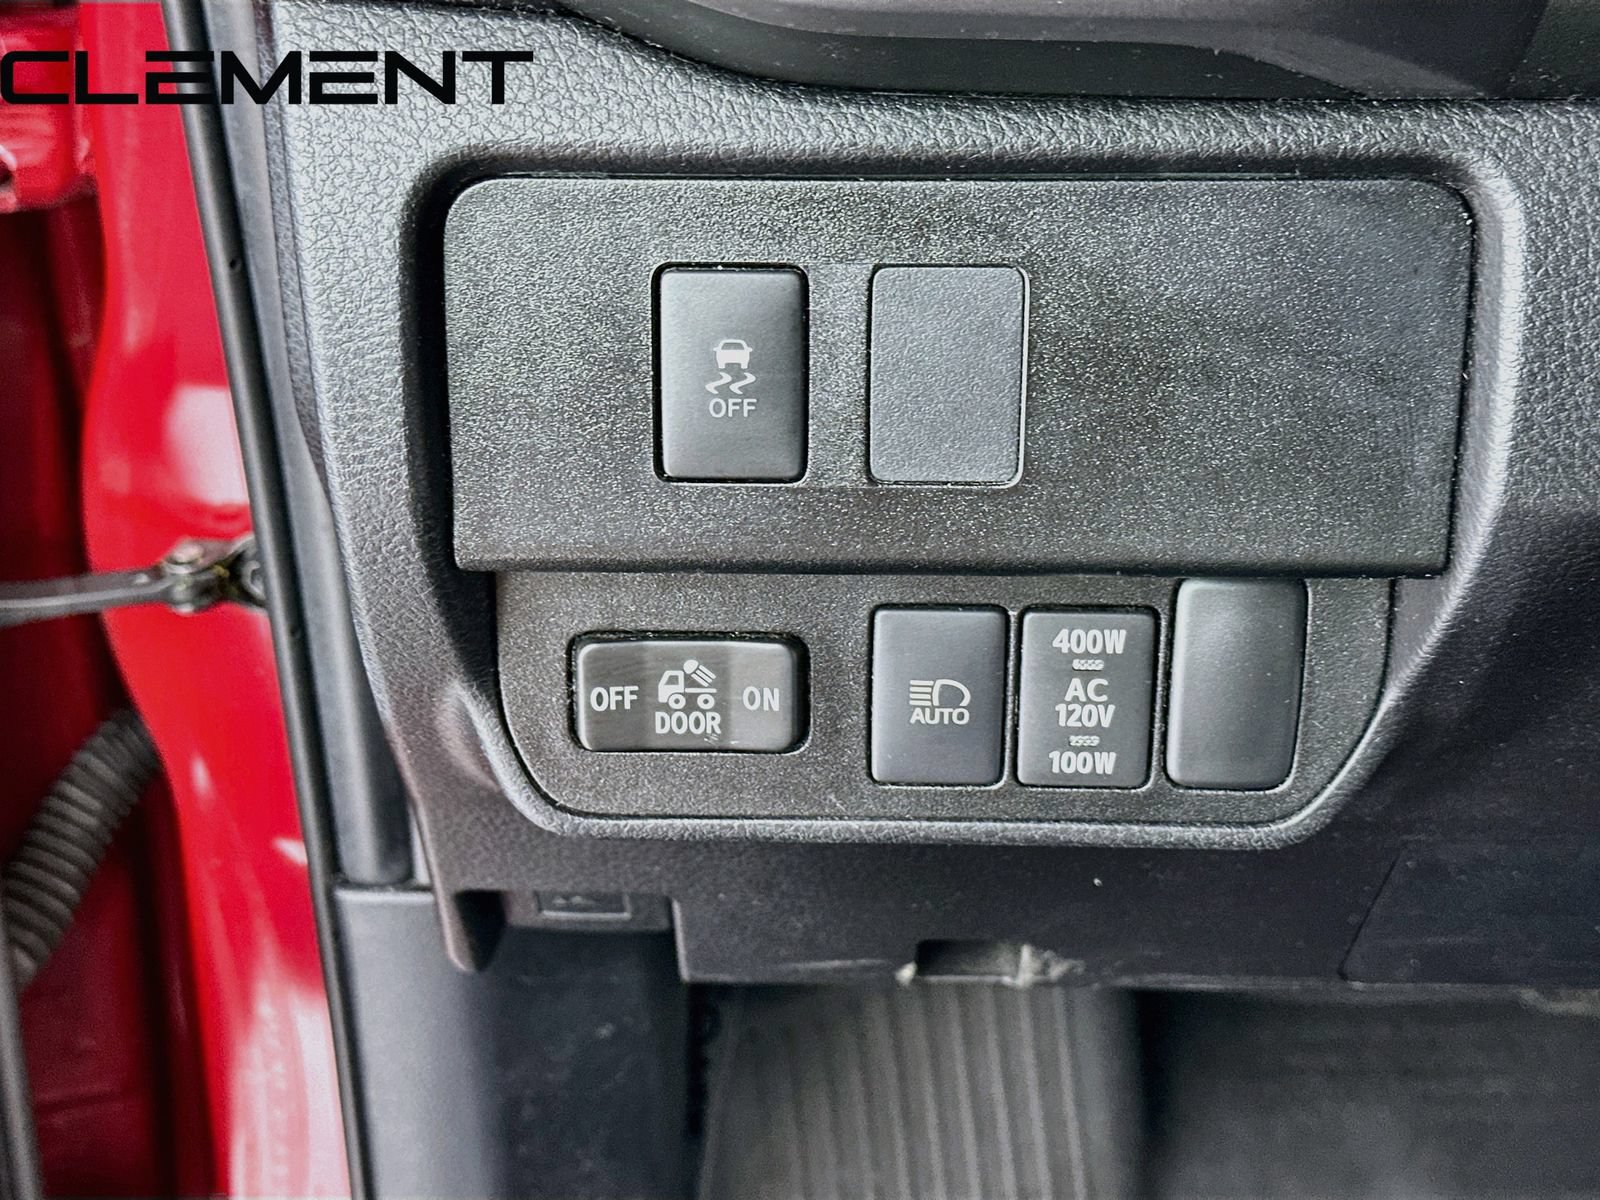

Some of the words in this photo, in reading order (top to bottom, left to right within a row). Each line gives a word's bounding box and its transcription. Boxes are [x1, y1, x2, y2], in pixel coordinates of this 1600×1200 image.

[708, 397, 758, 418] OFF
[1052, 628, 1127, 654] 400W
[590, 685, 639, 712] OFF
[742, 686, 780, 712] ON
[1064, 677, 1109, 702] AC
[655, 711, 722, 734] DOOR
[909, 707, 970, 725] AUTO
[1055, 703, 1116, 728] 120V
[1049, 751, 1117, 775] 100W
